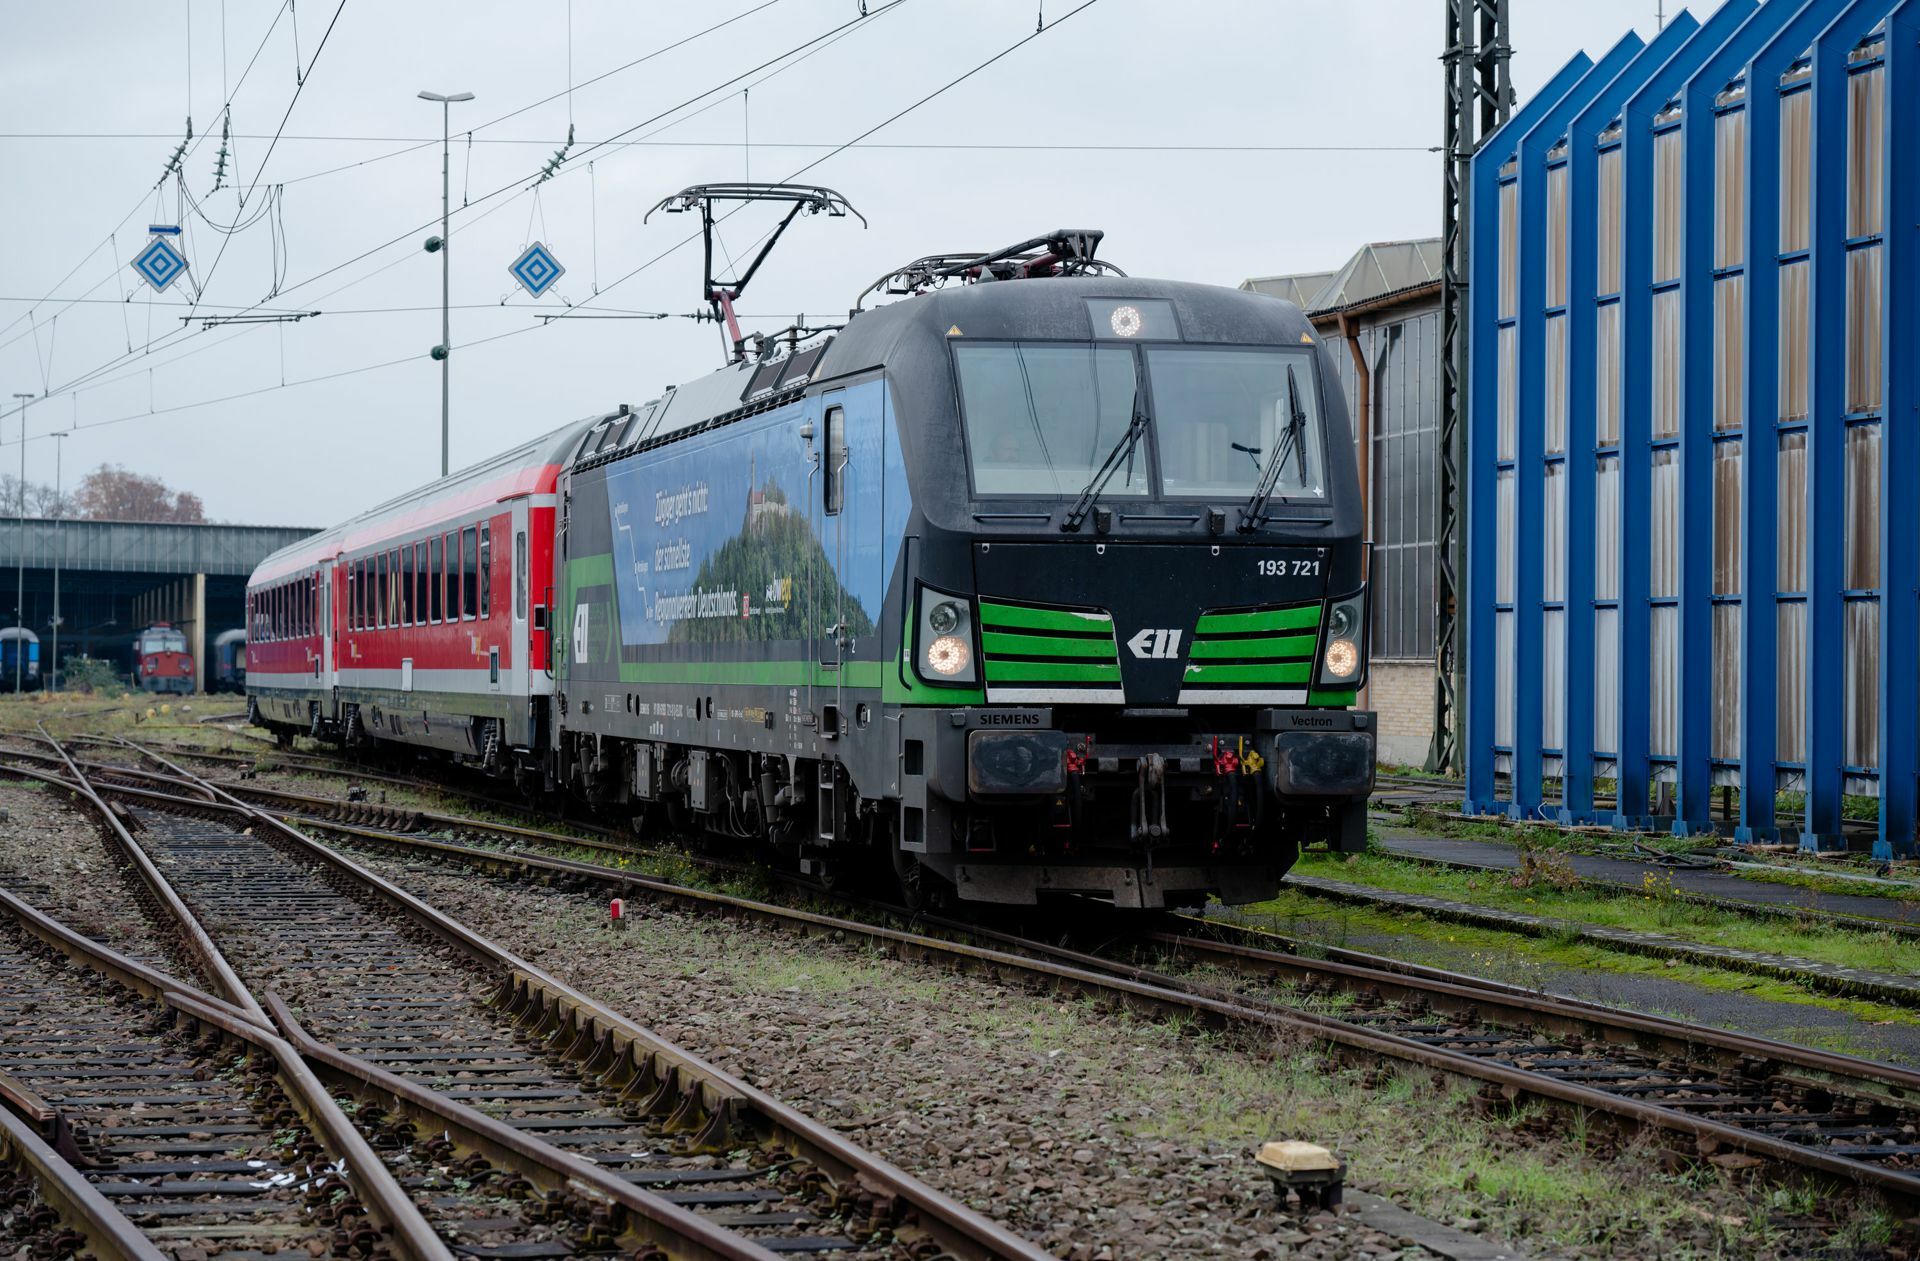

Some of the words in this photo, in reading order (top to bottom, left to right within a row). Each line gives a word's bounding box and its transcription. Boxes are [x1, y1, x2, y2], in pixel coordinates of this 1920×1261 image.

[1257, 560, 1287, 576] 193
[1291, 560, 1320, 576] 721
[655, 587, 697, 627] Regionalverkehr
[980, 714, 1040, 725] SIEMENS
[1291, 715, 1333, 726] Vectron
